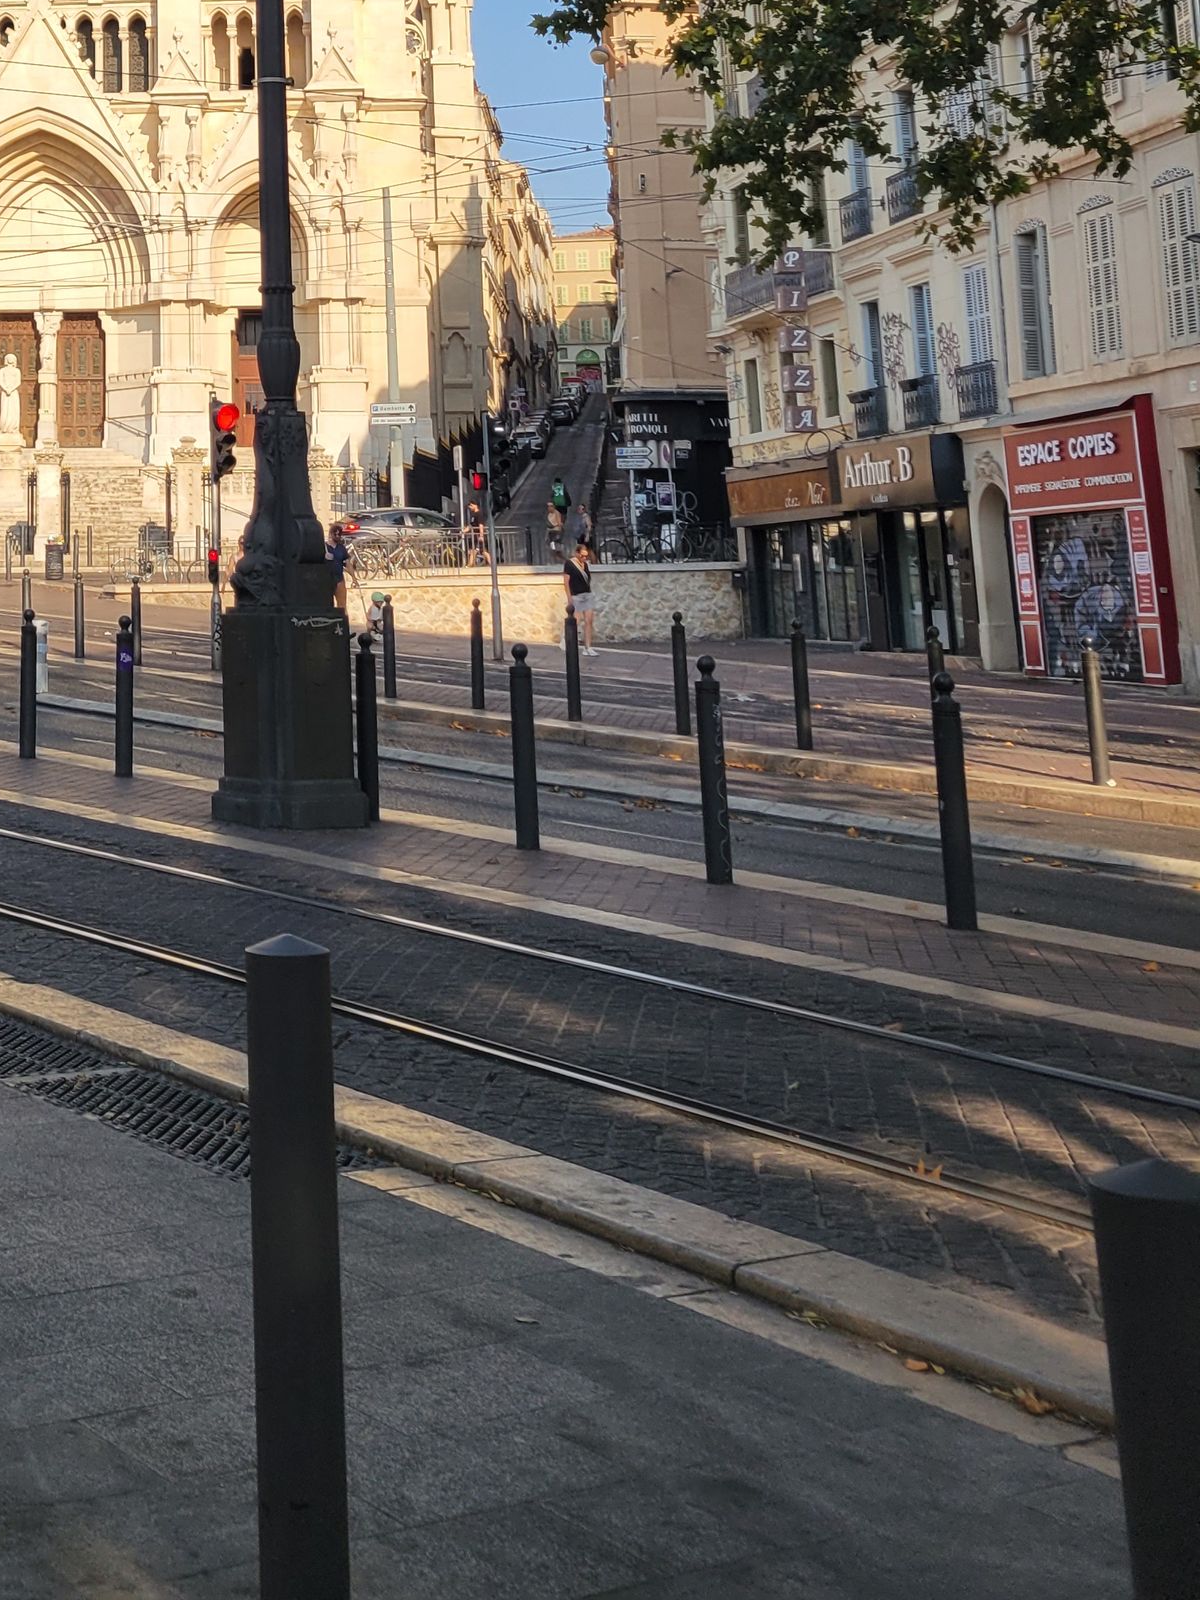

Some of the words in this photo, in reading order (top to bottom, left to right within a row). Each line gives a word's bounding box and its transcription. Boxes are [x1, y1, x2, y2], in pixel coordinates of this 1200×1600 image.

[784, 251, 814, 429] PIZZA
[1017, 440, 1061, 467] ESPACE
[1068, 432, 1116, 460] COPIES
